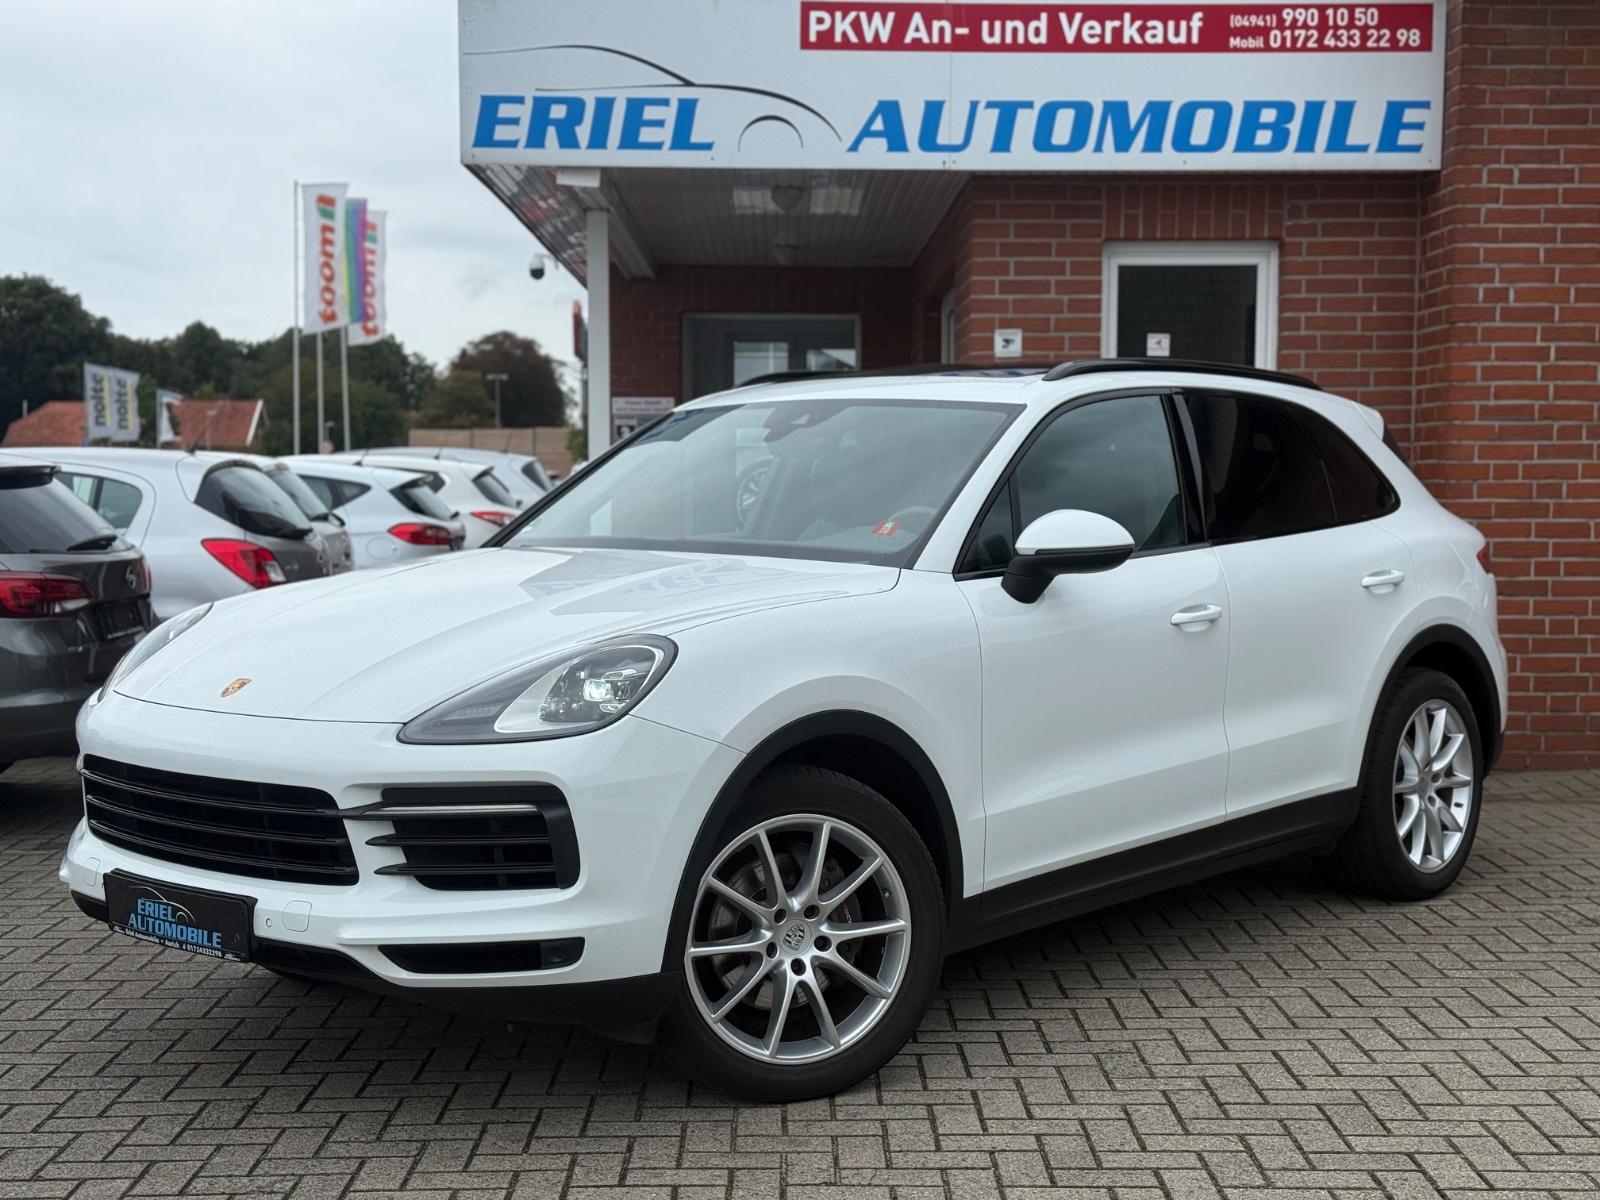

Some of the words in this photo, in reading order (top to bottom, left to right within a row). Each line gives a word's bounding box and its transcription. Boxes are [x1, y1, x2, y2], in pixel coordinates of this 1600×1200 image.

[808, 10, 895, 43] PKW
[903, 12, 969, 44] An-
[981, 12, 1048, 44] und
[1058, 12, 1204, 44] Verkauf
[1229, 14, 1277, 28] (04941)
[1282, 8, 1319, 26] 990
[1325, 8, 1349, 26] 10
[1354, 8, 1379, 26] 50
[1229, 36, 1264, 48] Mobil
[1269, 29, 1319, 48] 0172
[1323, 29, 1361, 47] 433
[1366, 29, 1391, 47] 22
[1396, 29, 1421, 47] 98
[471, 95, 715, 151] ERIEL
[846, 100, 1431, 153] AUTOMOBILE
[317, 222, 338, 326] toom
[137, 898, 176, 922] ERIEL
[128, 913, 222, 948] AUTOMOBILE
